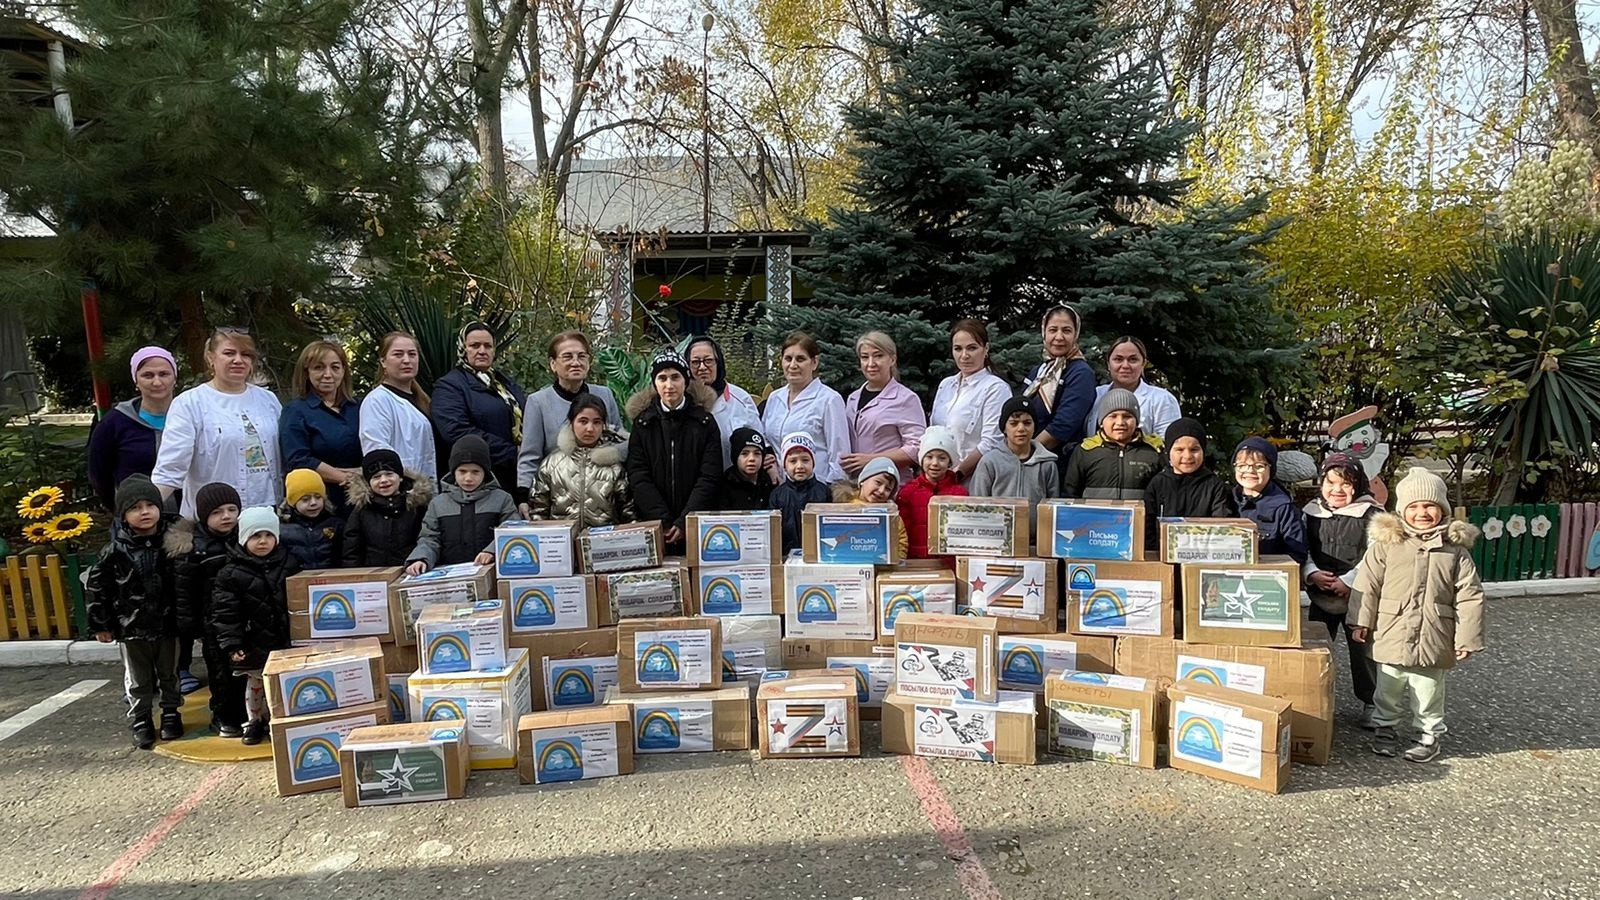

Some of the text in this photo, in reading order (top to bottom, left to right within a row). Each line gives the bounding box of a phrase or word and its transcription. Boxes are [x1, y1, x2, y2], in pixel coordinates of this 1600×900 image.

[656, 355, 686, 368] RUSSIA
[947, 527, 1004, 537] ПОДАРОК СОЛДАТУ
[1089, 530, 1119, 540] Письмо
[850, 535, 878, 545] Письмо
[1088, 539, 1119, 549] солдату
[850, 544, 879, 552] солдату
[1177, 551, 1243, 560] ПОДАРОК СОЛДАТУ
[900, 684, 957, 696] ПОСЫЛКА СОЛДАТУ
[1058, 726, 1121, 743] ПОДАРОК СОЛДАТУ
[918, 745, 977, 758] ПОСЫЛКА СОЛДАТУ
